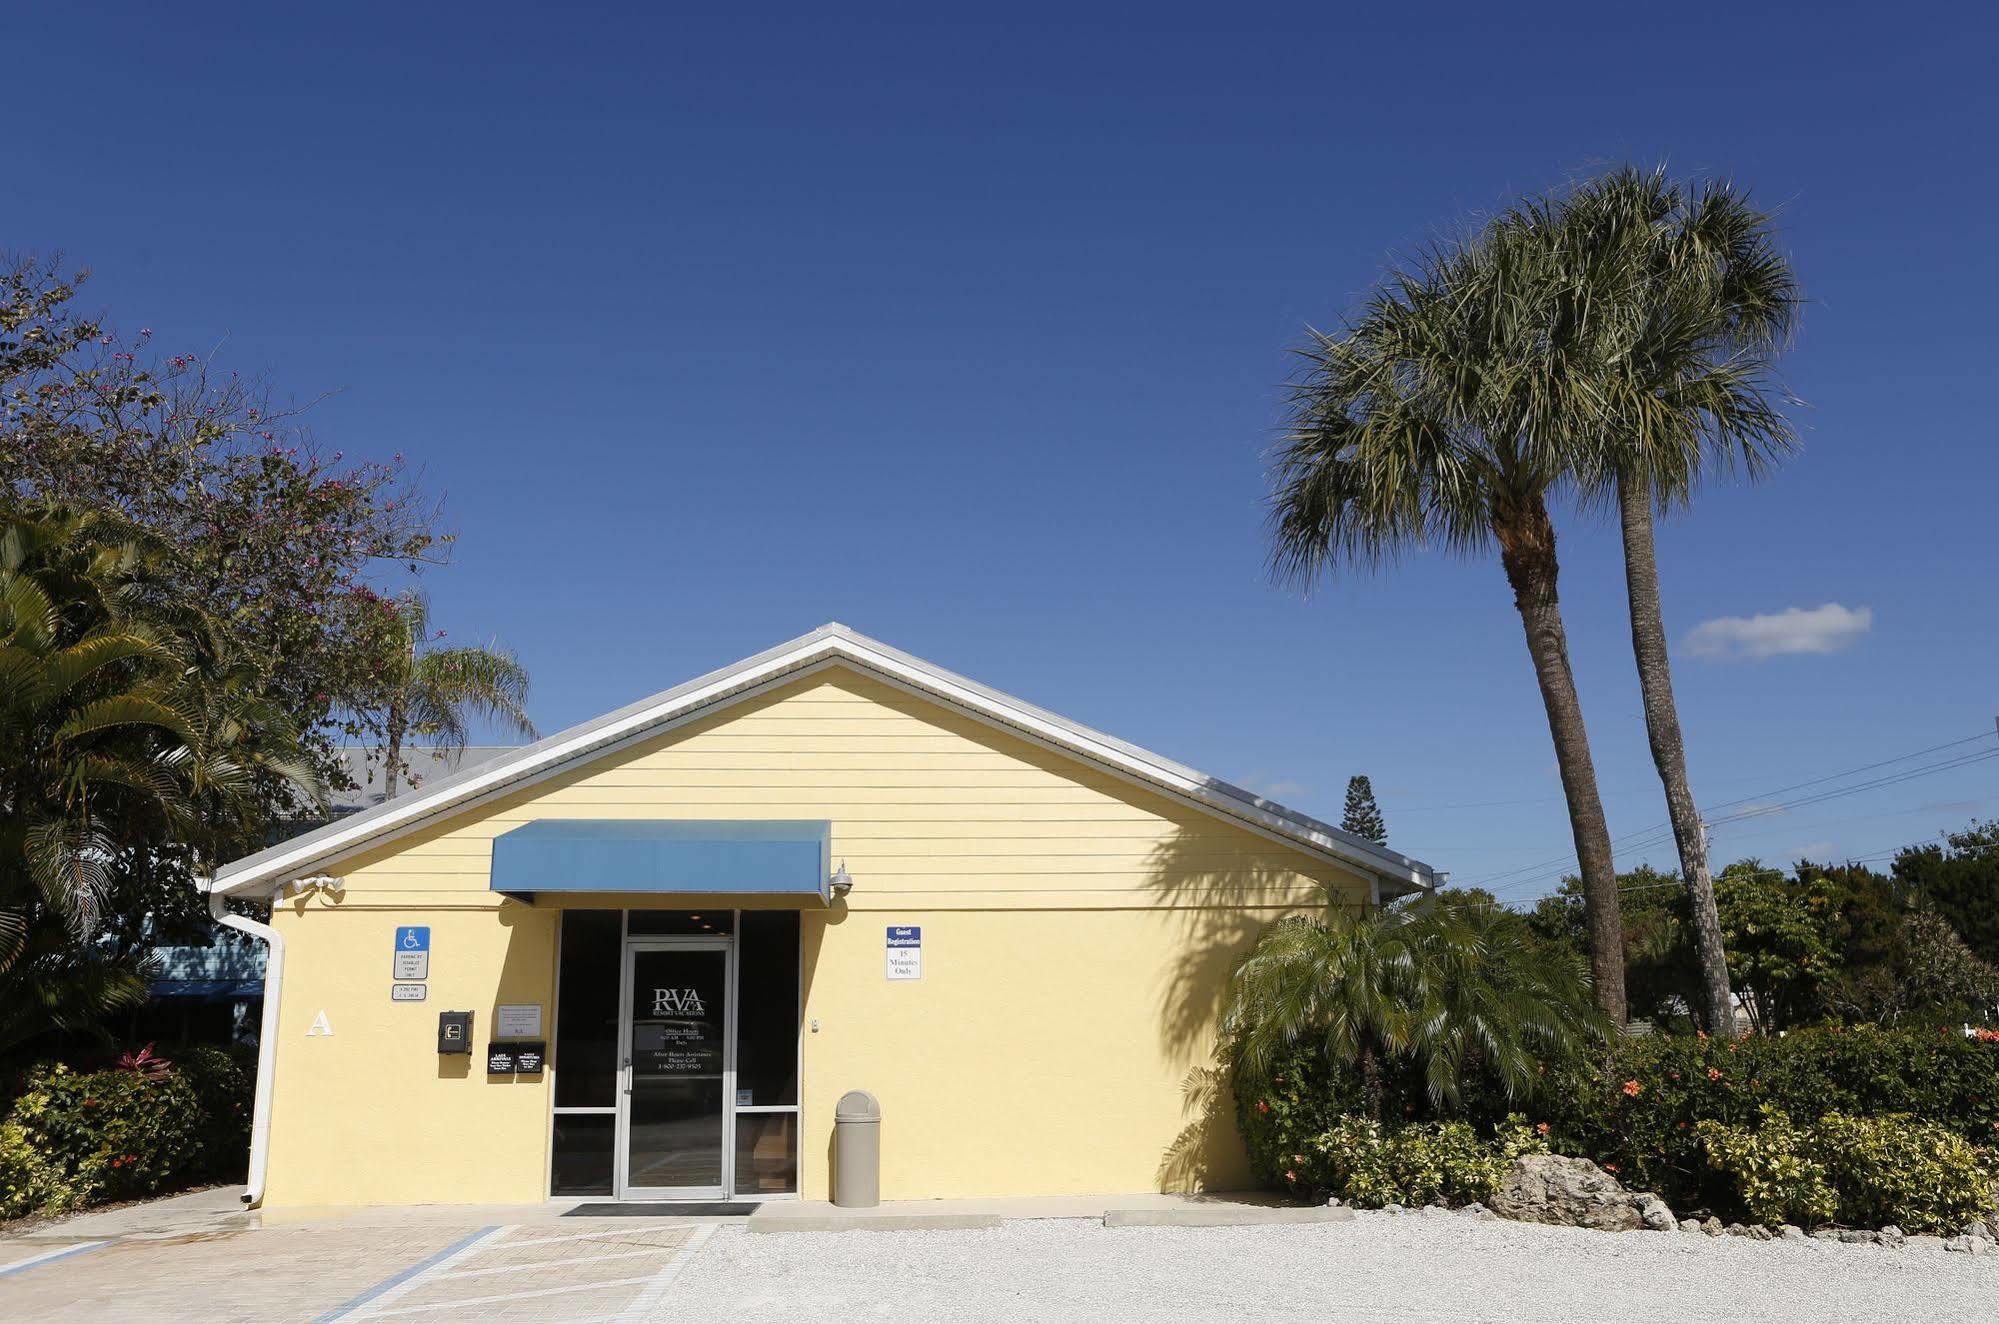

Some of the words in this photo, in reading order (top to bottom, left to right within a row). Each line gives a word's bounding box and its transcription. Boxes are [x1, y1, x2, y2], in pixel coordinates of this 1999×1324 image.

[888, 937, 920, 946] Registration
[895, 967, 912, 976] Only
[652, 988, 707, 1011] RVA
[305, 1009, 335, 1036] A
